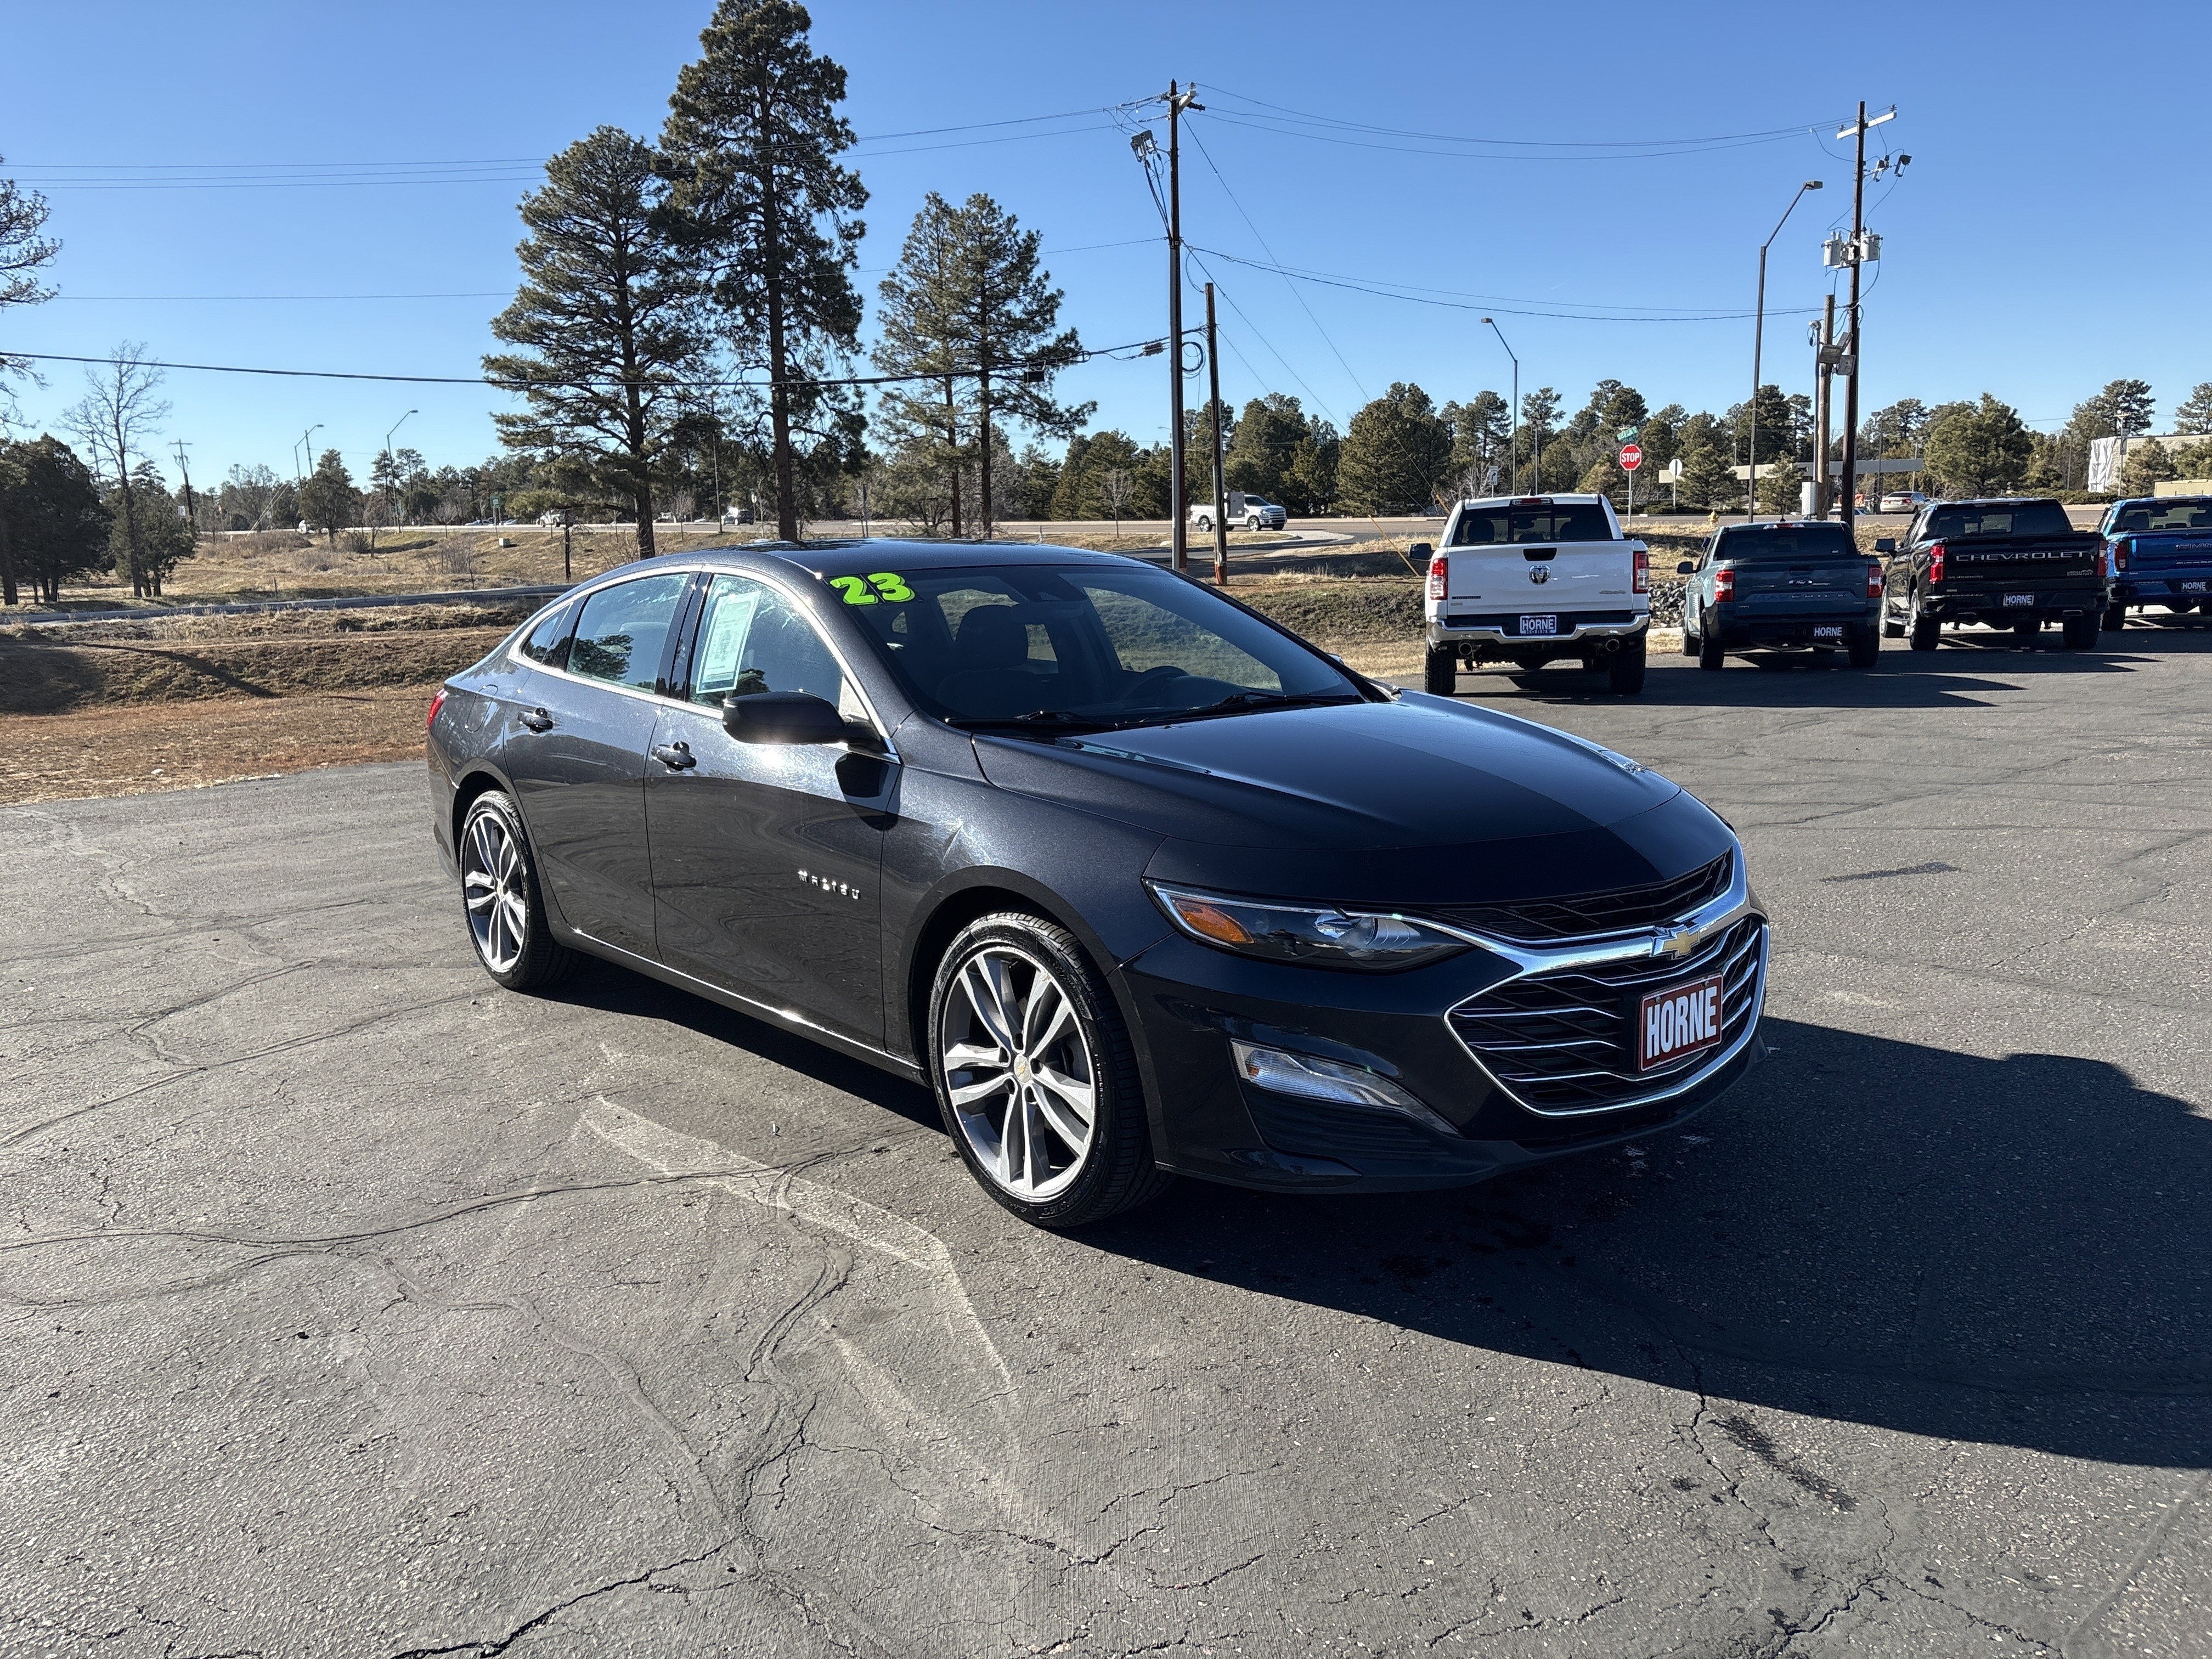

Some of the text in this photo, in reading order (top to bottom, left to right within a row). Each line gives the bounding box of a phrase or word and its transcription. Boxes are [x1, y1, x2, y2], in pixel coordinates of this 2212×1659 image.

[1622, 453, 1640, 463] STOP
[1956, 551, 2087, 562] CHEVROLET
[830, 572, 916, 606] 23
[2182, 582, 2207, 590] HORNE
[2005, 595, 2032, 604] HORNE
[1522, 619, 1554, 630] HORNE
[1814, 627, 1843, 637] HORNE
[798, 870, 860, 900] MALIBU
[1647, 986, 1717, 1059] HORNE
